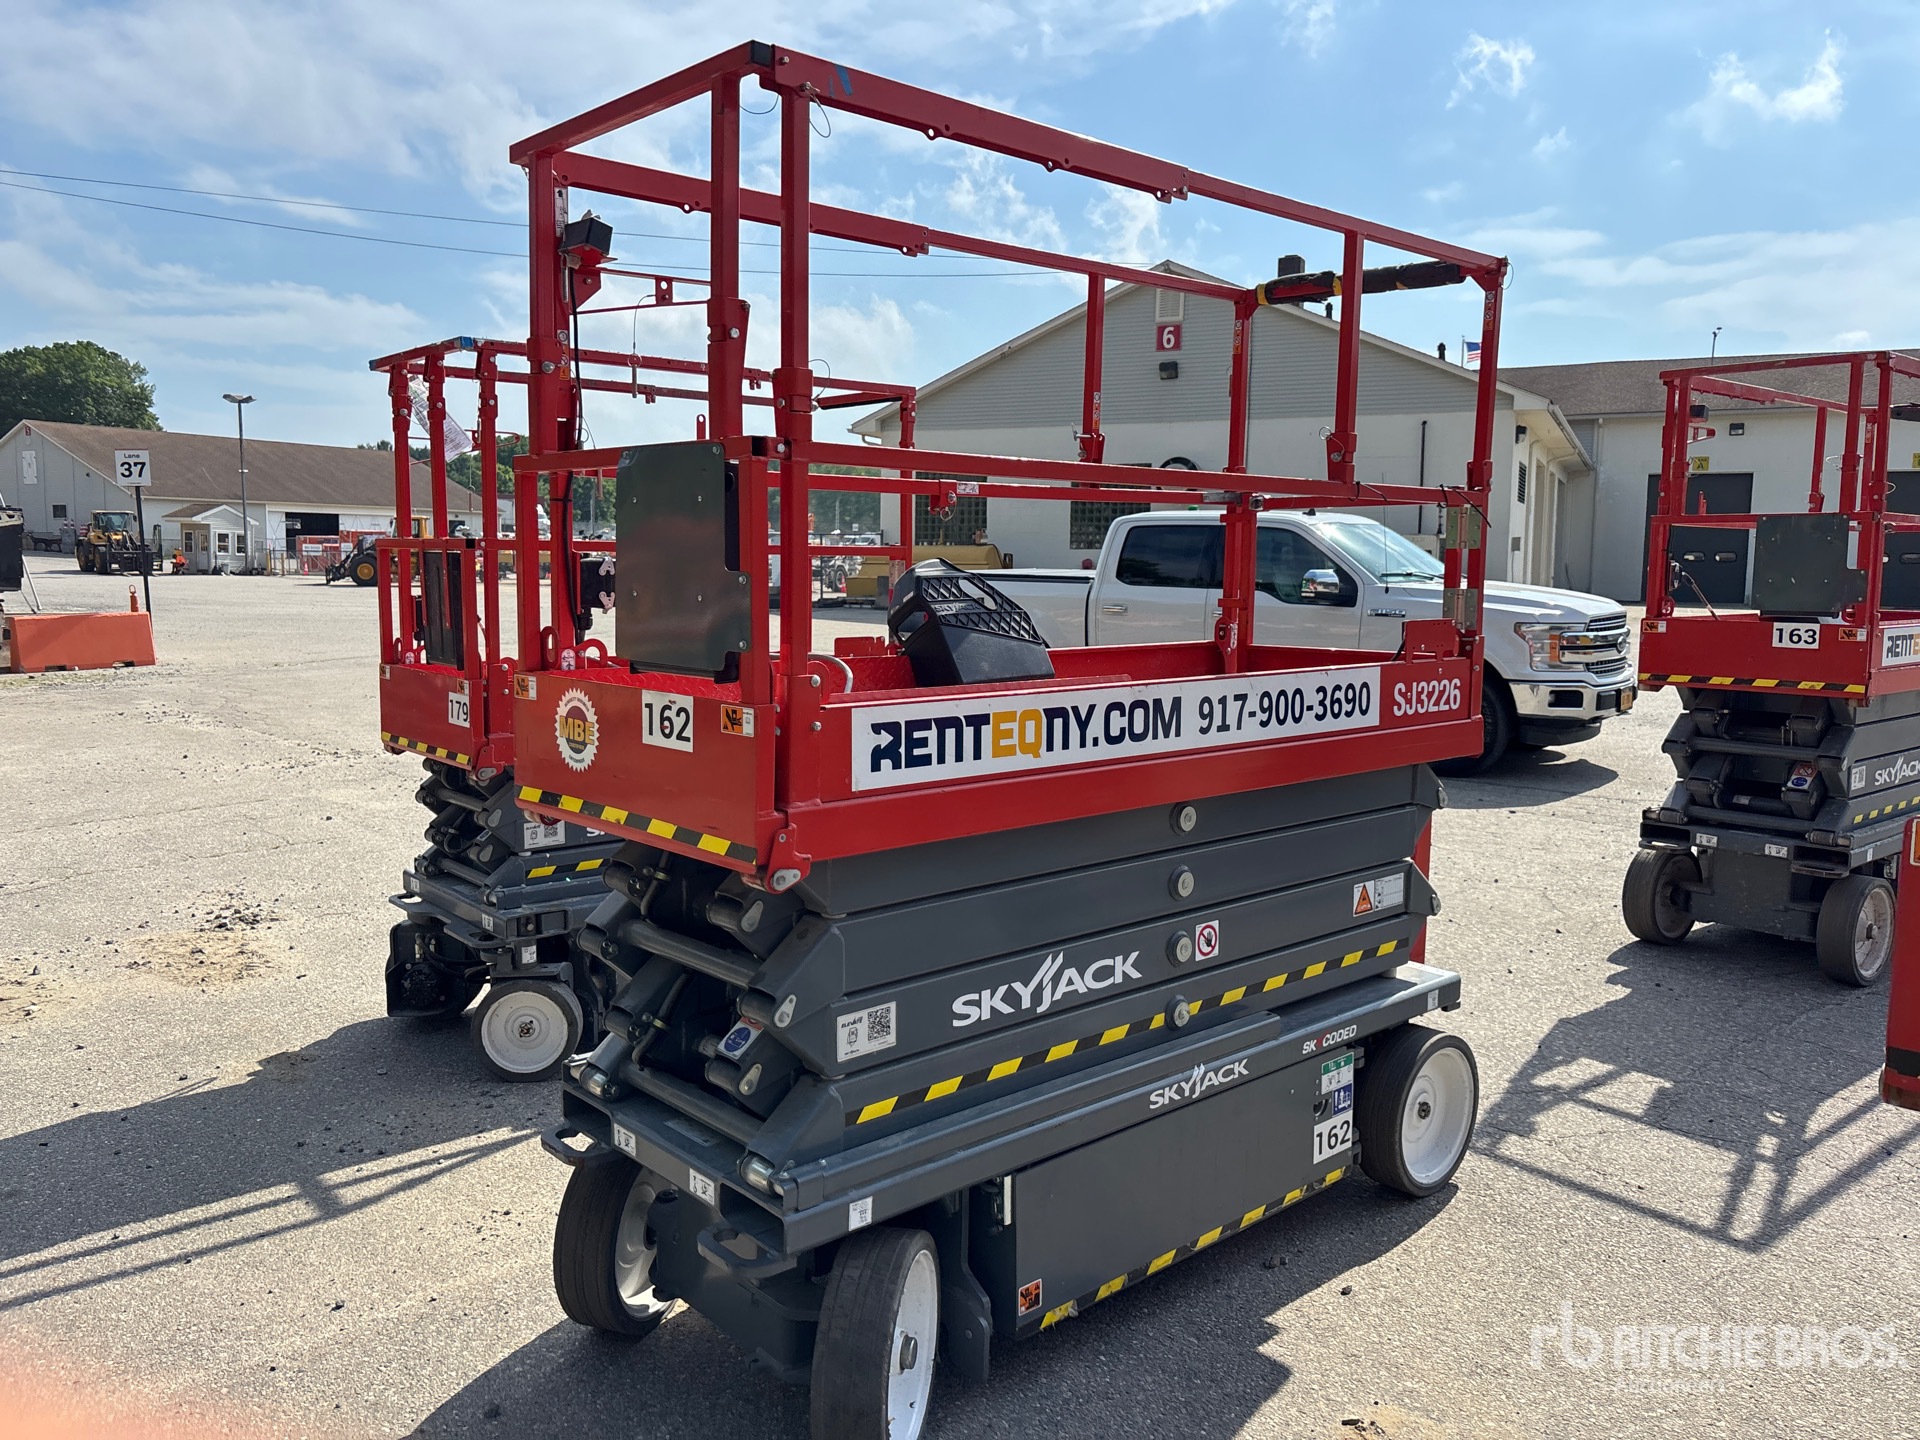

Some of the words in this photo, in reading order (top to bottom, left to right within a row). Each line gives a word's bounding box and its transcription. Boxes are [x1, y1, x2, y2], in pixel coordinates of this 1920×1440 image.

[1162, 326, 1175, 349] 6
[120, 461, 146, 478] 37
[1775, 628, 1817, 645] 163
[449, 699, 469, 722] 179
[1393, 678, 1461, 717] SJ3226
[559, 715, 595, 745] MBE
[644, 702, 691, 743] 162
[870, 696, 1182, 773] RENTEQNY.COM
[1198, 681, 1371, 735] 917-900-3690
[1874, 756, 1920, 786] SKYJAC
[951, 950, 1143, 1027] SKYJACK
[1149, 1058, 1250, 1109] SKYJACK
[1315, 1119, 1351, 1156] 162
